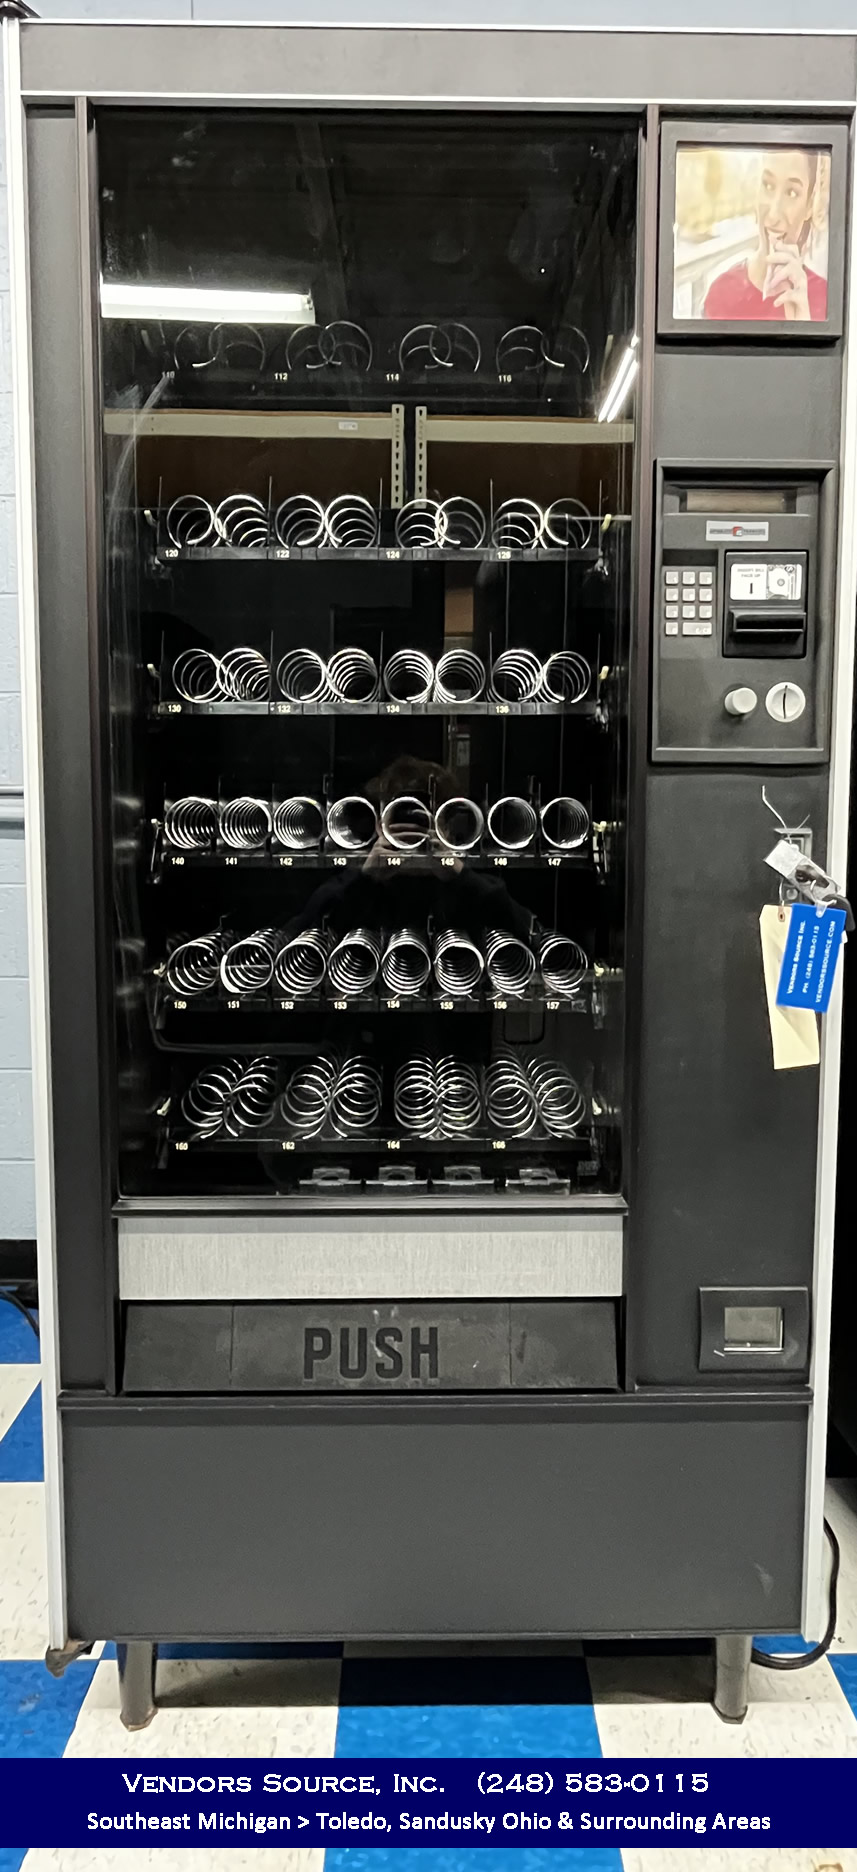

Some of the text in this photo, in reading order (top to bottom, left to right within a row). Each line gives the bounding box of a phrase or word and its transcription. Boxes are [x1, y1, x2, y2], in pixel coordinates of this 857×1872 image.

[276, 550, 290, 558] 122
[386, 551, 400, 559] 124
[167, 704, 182, 712] 130
[277, 705, 291, 713] 132
[171, 857, 185, 865] 140
[225, 857, 238, 865] 141
[279, 858, 293, 866] 142
[333, 858, 347, 866] 143
[441, 858, 455, 866] 145
[548, 858, 561, 866] 147
[815, 920, 836, 1003] VENDORSSOURCE.COM
[174, 1001, 187, 1009] 150
[227, 1001, 240, 1009] 151
[334, 1002, 347, 1010] 153
[546, 1002, 560, 1010] 157
[387, 1141, 400, 1149] 164
[304, 1327, 438, 1379] PUSH
